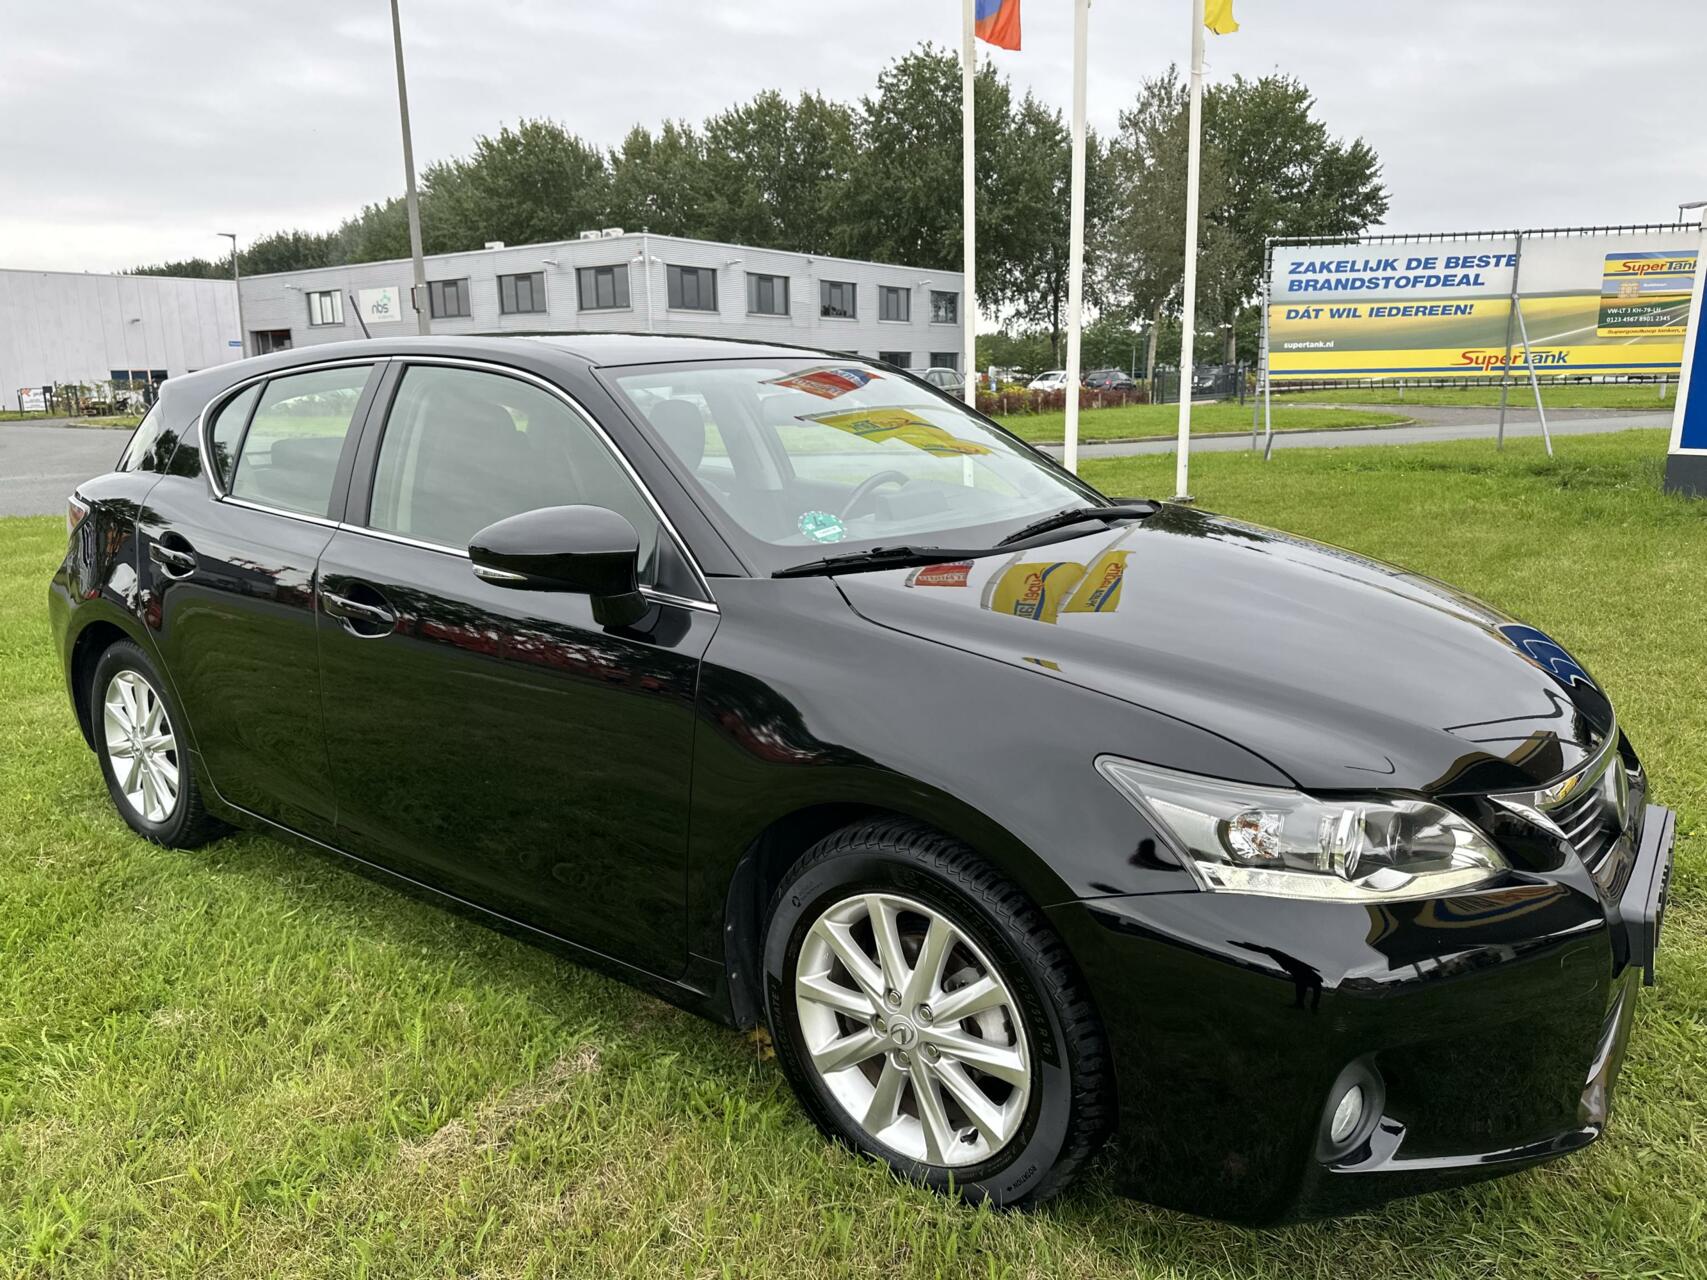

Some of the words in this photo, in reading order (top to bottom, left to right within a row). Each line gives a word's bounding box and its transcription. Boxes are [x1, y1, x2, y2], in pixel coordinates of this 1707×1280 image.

[1288, 258, 1399, 274] ZAKELIJK
[1405, 256, 1438, 271] DE
[1444, 253, 1521, 270] BESTE
[1288, 273, 1485, 292] BRANDSTOFDEAL
[371, 300, 389, 314] nbs
[1286, 305, 1324, 320] DÁT
[1329, 307, 1361, 319] WIL
[1368, 304, 1474, 318] IEDEREEN!
[1284, 340, 1334, 349] supertank.nl
[1450, 350, 1570, 371] SuperTank
[1012, 1163, 1038, 1189] ROTATION
